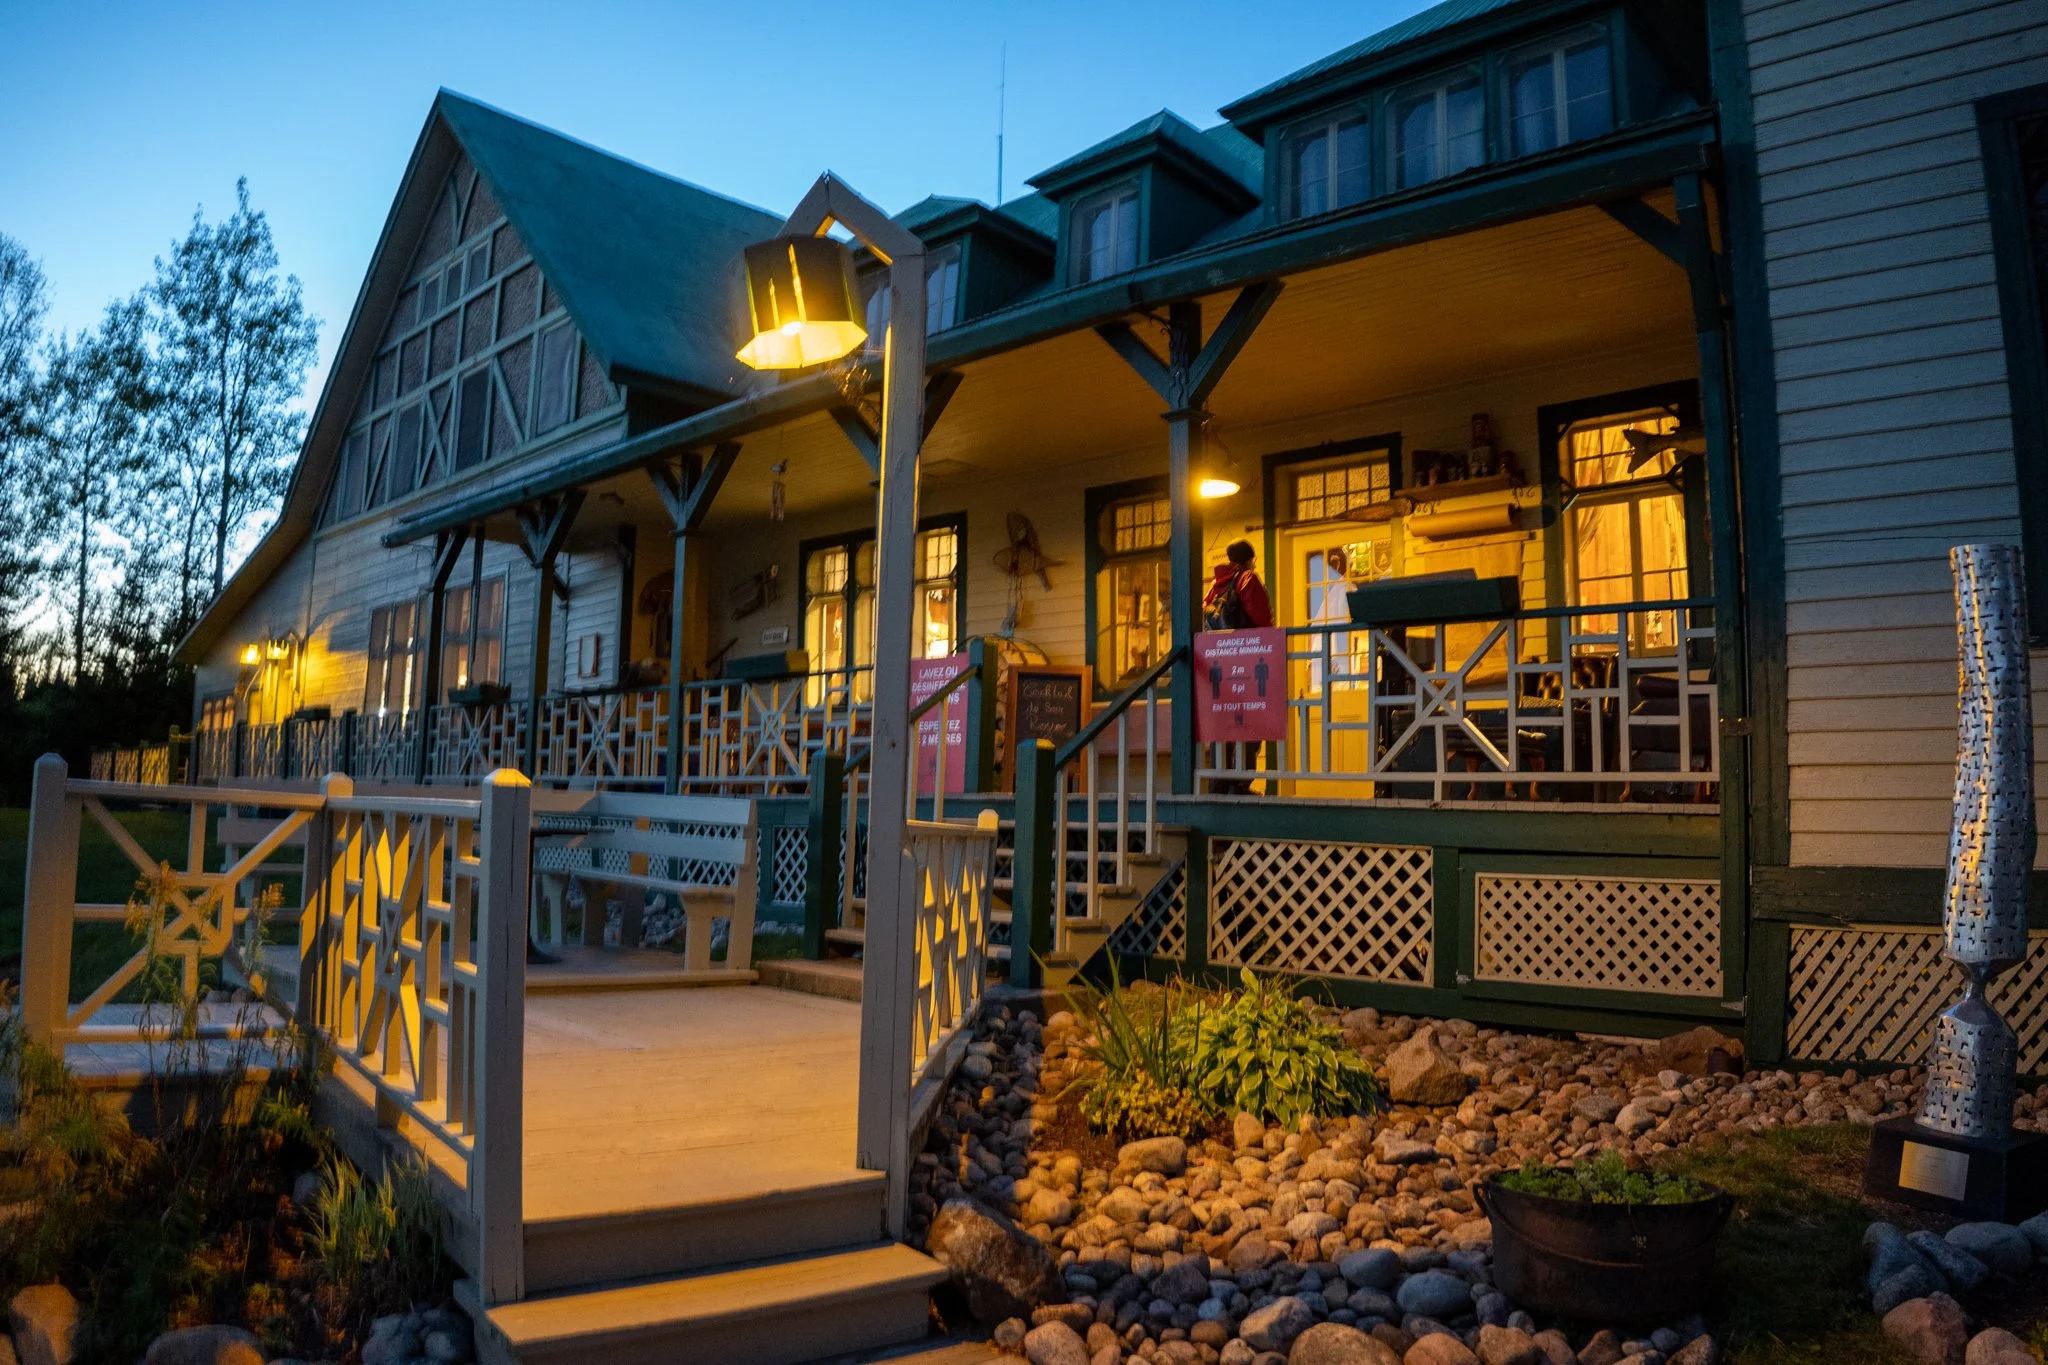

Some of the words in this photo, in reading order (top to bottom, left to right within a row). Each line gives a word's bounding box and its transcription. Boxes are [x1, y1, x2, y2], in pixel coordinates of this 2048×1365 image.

[1216, 638, 1245, 648] GARDEZ
[1246, 637, 1261, 645] UNE
[1205, 647, 1238, 657] DISTANCE
[1240, 645, 1272, 654] MINIMALE
[919, 667, 944, 679] LAVEZ
[945, 665, 958, 678] OU
[1232, 665, 1237, 675] 2
[1237, 684, 1245, 693] pi
[1212, 703, 1222, 712] EN
[1223, 702, 1242, 712] TOUT
[1243, 701, 1266, 709] TEMPS
